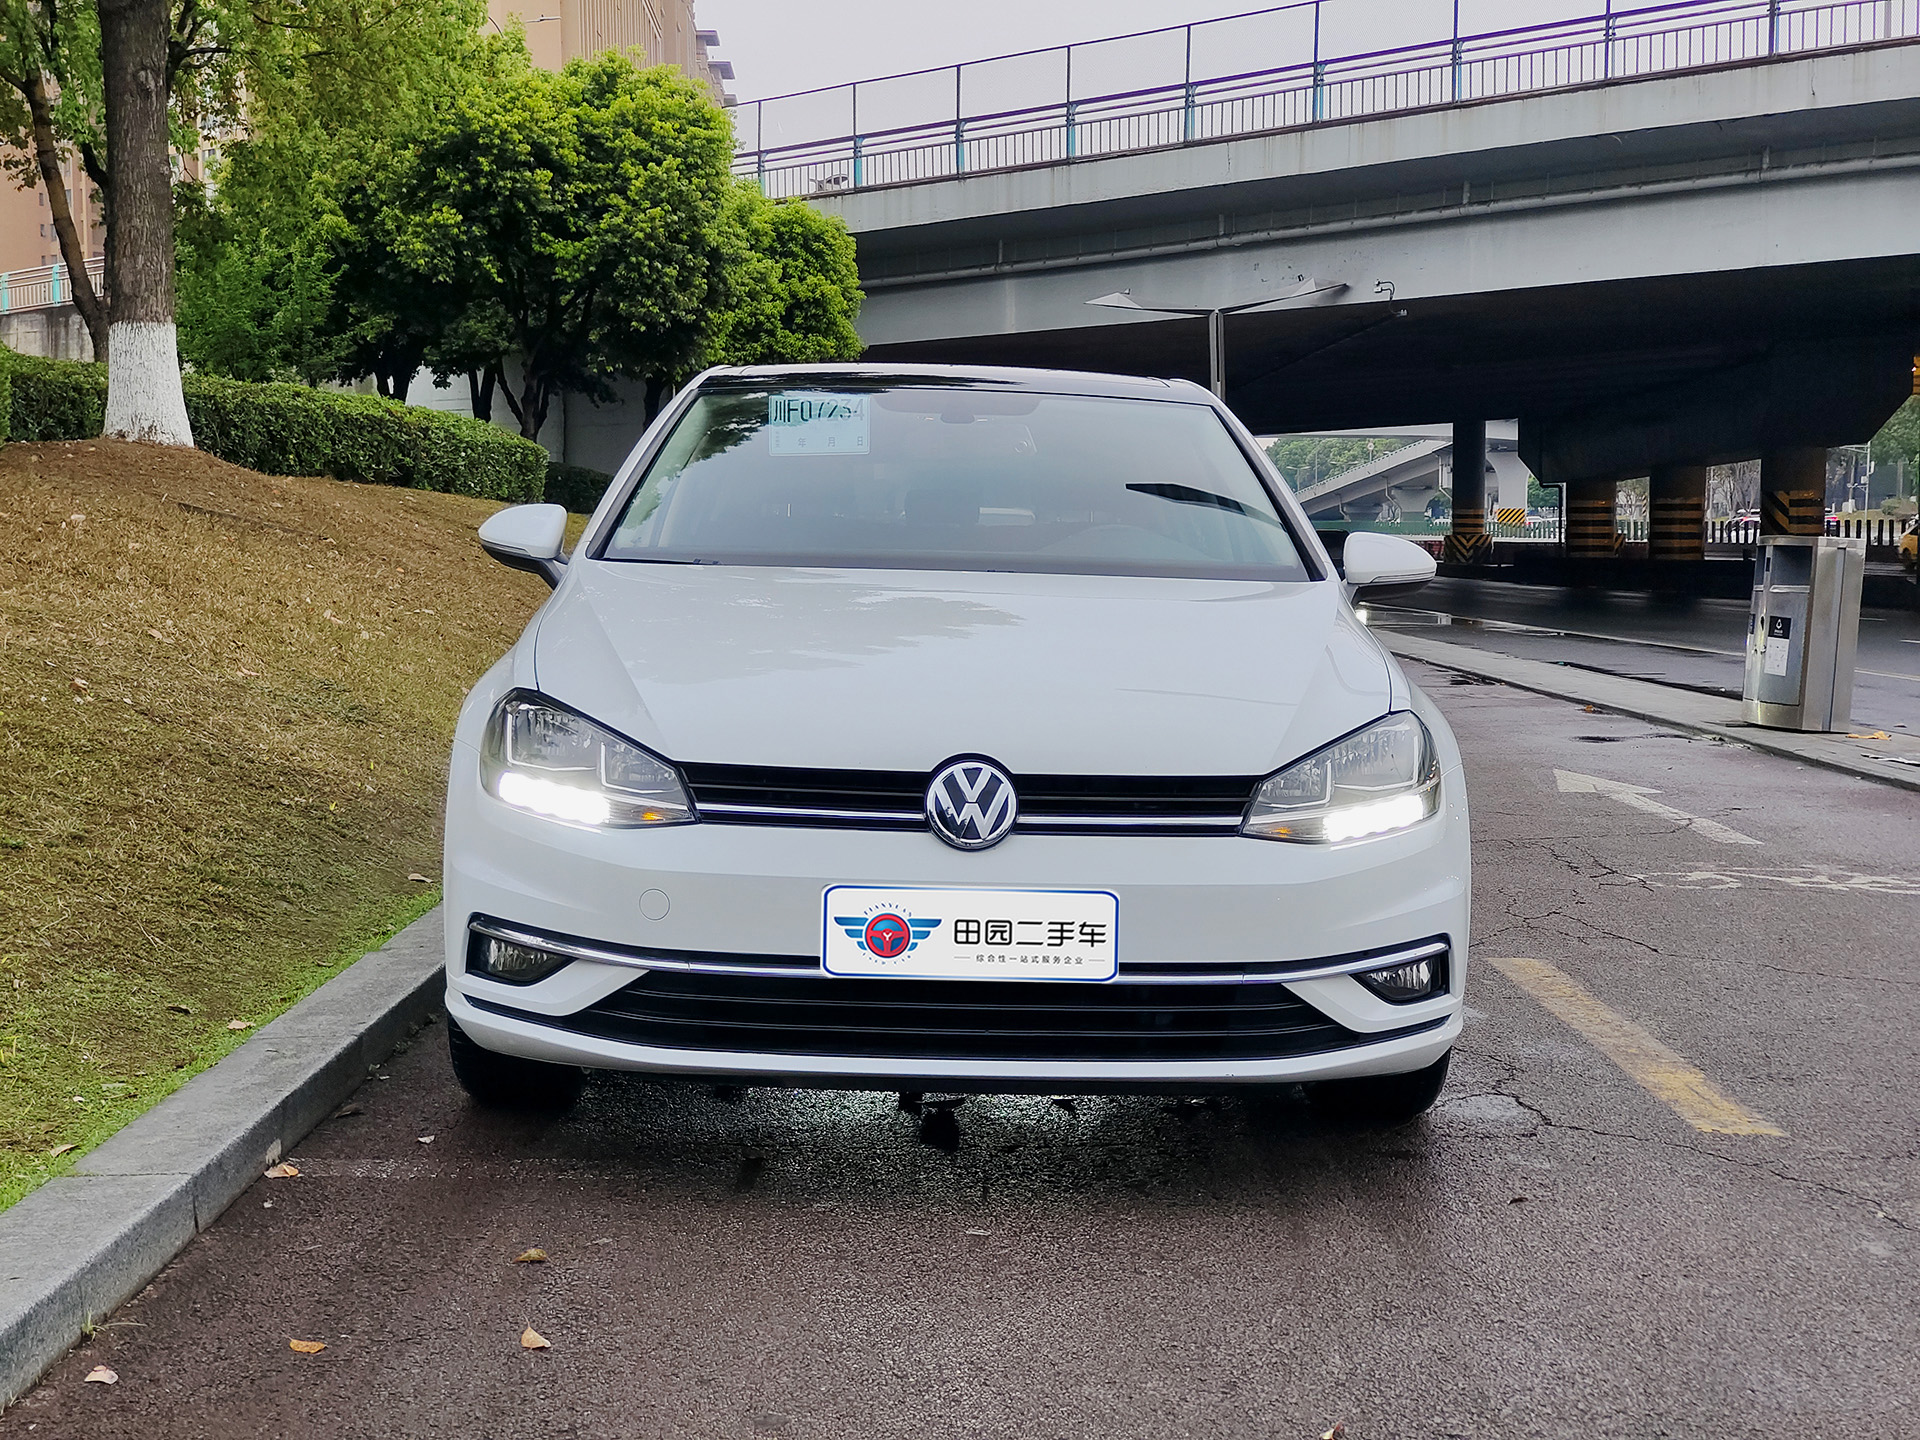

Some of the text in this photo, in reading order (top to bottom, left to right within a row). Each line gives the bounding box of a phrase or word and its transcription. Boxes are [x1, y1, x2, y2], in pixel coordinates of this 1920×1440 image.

[773, 399, 864, 422] 川F07234
[954, 919, 1108, 947] 田园二手车
[975, 954, 1084, 965] 综合性一站式服务企业
